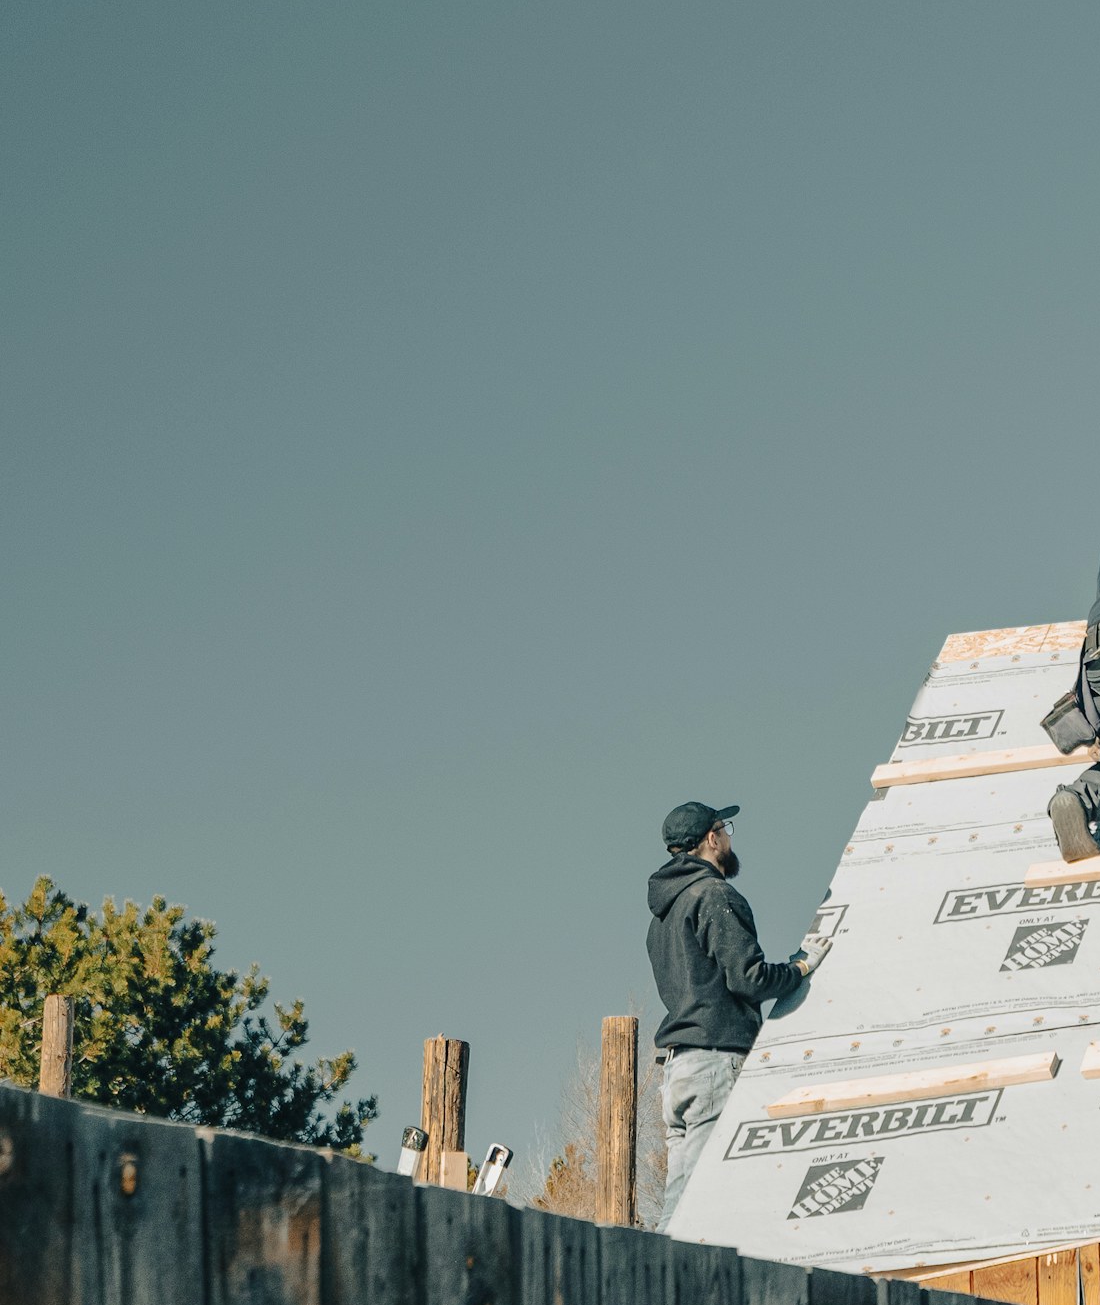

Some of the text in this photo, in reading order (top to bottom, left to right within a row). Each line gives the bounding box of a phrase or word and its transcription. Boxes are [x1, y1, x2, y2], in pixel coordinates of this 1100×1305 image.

[1019, 917, 1042, 925] ONLY
[1003, 920, 1088, 971] HOME
[1016, 927, 1052, 949] THE
[1029, 935, 1081, 968] DEPOT
[738, 1096, 989, 1152] EVERBILT
[811, 1152, 849, 1164] ONLY AT
[791, 1158, 882, 1218] HOME
[806, 1166, 845, 1192] THE
[819, 1176, 874, 1216] DEPOT
